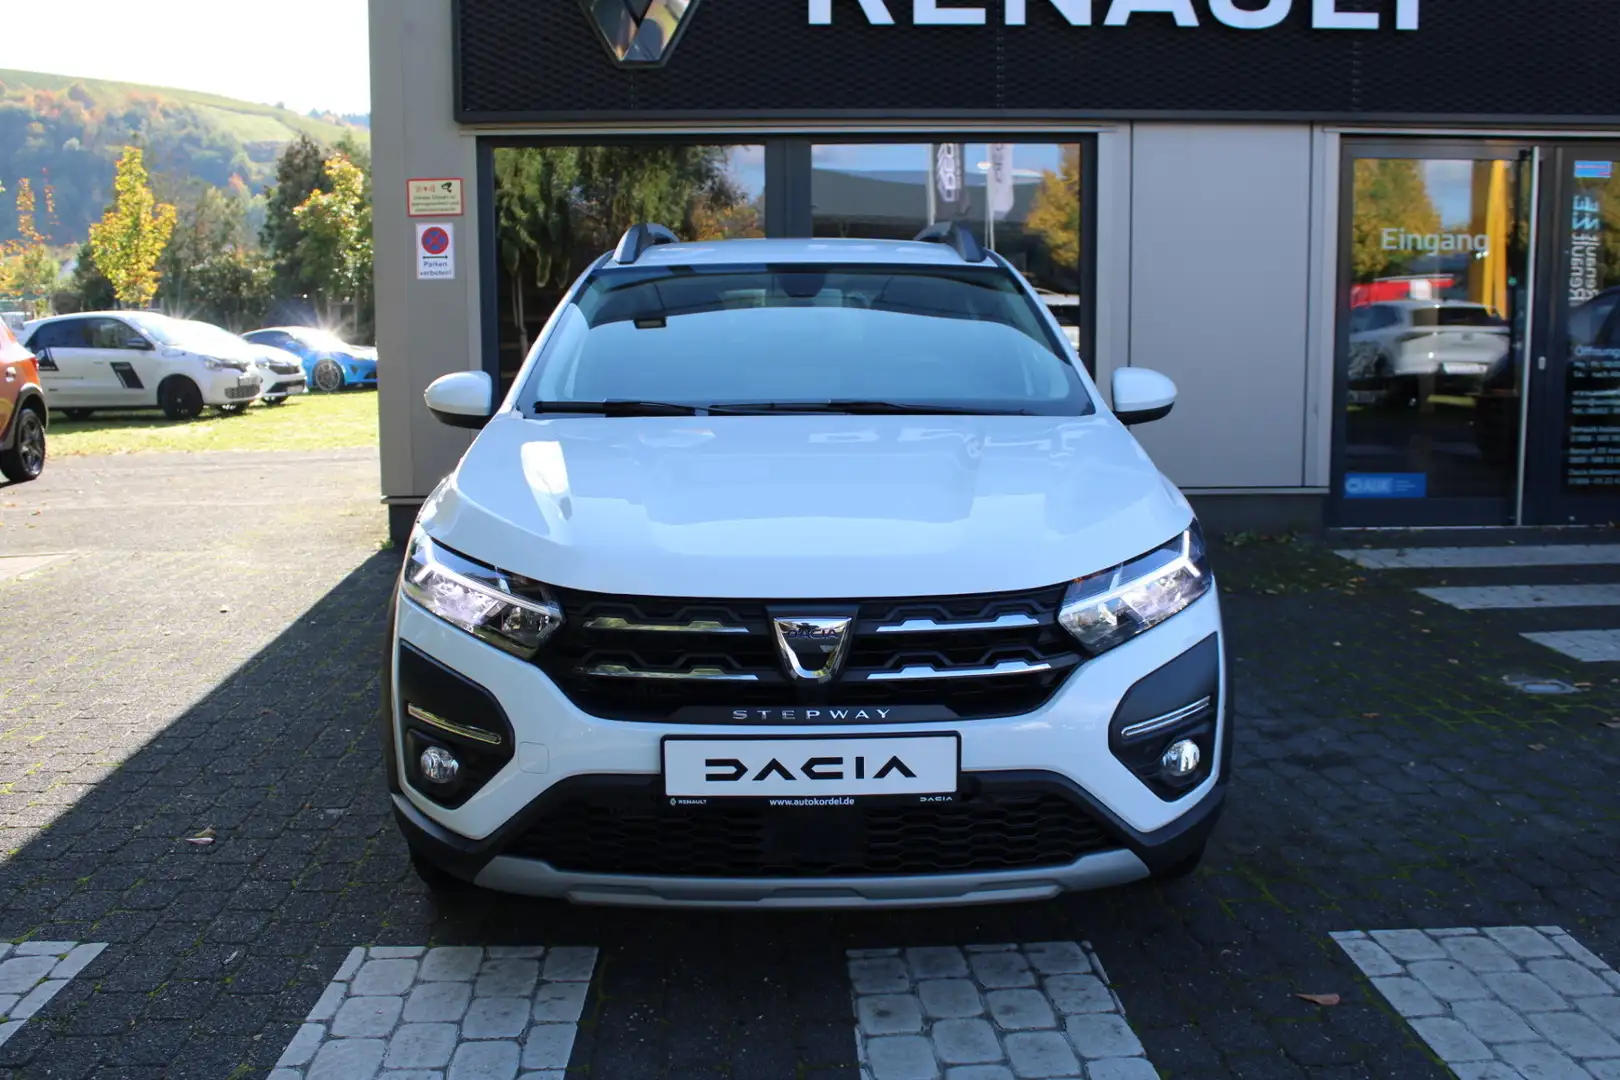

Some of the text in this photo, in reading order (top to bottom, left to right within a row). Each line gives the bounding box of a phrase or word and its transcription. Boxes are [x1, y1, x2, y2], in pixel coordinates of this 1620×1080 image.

[1382, 227, 1490, 258] Eingang
[732, 708, 890, 720] STEPWAY
[705, 755, 918, 781] DACIA
[769, 797, 855, 806] www.autokordel.de
